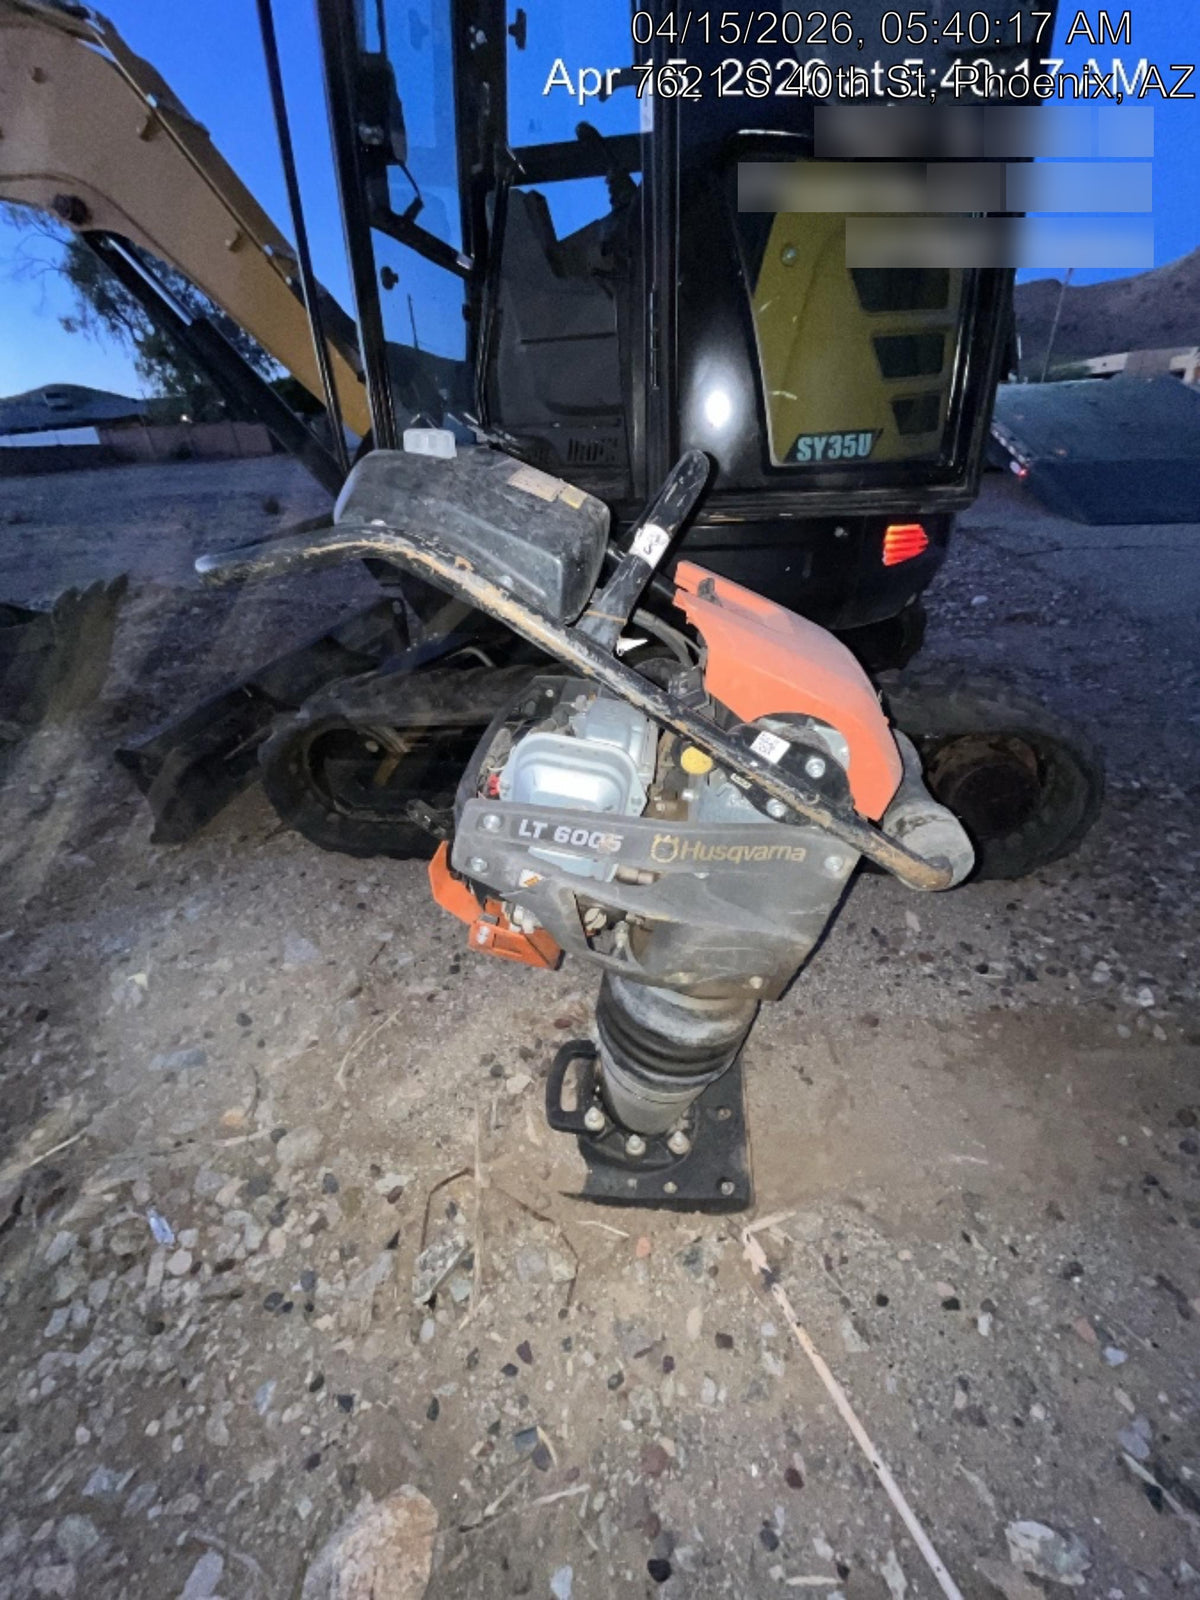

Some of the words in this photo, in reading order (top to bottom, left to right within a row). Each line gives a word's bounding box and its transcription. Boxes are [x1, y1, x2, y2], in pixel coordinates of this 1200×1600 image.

[797, 432, 872, 462] SY35U
[518, 818, 549, 839] LT
[680, 840, 807, 865] Husqvarna
